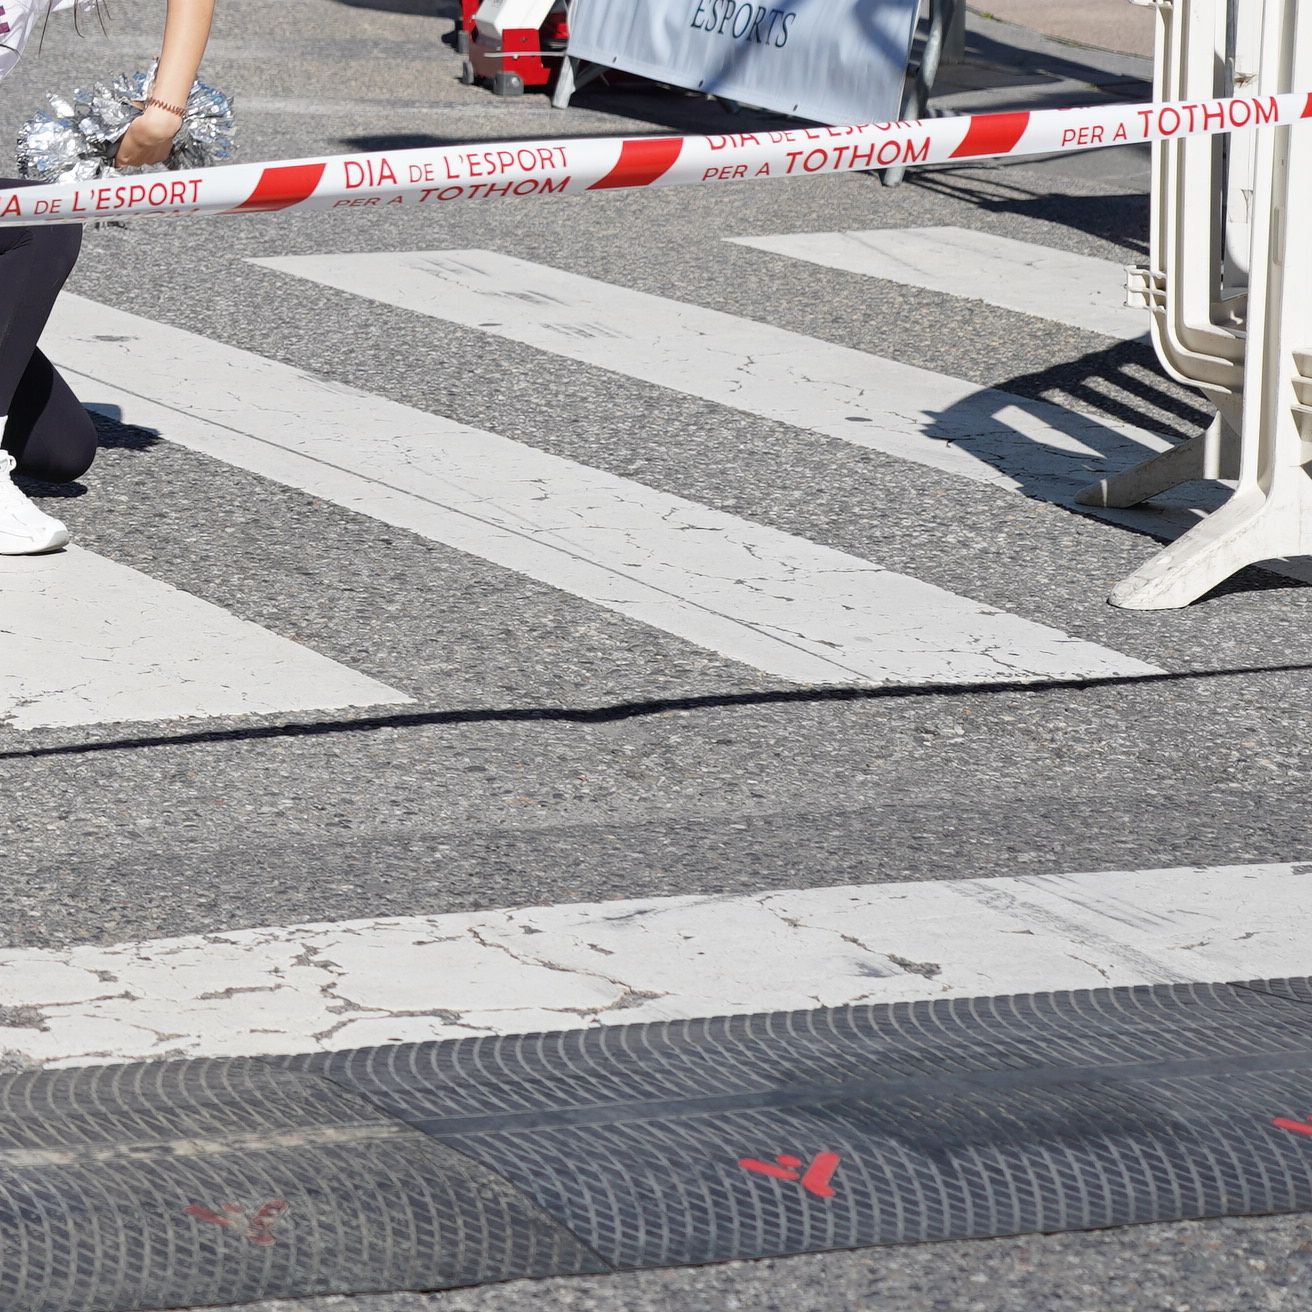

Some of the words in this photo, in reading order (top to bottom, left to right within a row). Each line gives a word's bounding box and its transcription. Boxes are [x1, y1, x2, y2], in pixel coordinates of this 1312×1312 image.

[1061, 125, 1103, 147] PER
[1112, 122, 1127, 141] A
[1137, 96, 1280, 138] TOTHOM
[344, 158, 398, 189] DIA
[409, 163, 435, 183] DE
[443, 147, 567, 180] L'ESPORT
[702, 164, 748, 181] PER
[755, 162, 770, 177] A
[785, 137, 931, 174] TOTHOM
[33, 199, 63, 215] DE
[72, 179, 203, 213] L'ESPORT
[333, 197, 381, 208] PER
[387, 195, 403, 204] A
[418, 176, 572, 202] TOTHOM
